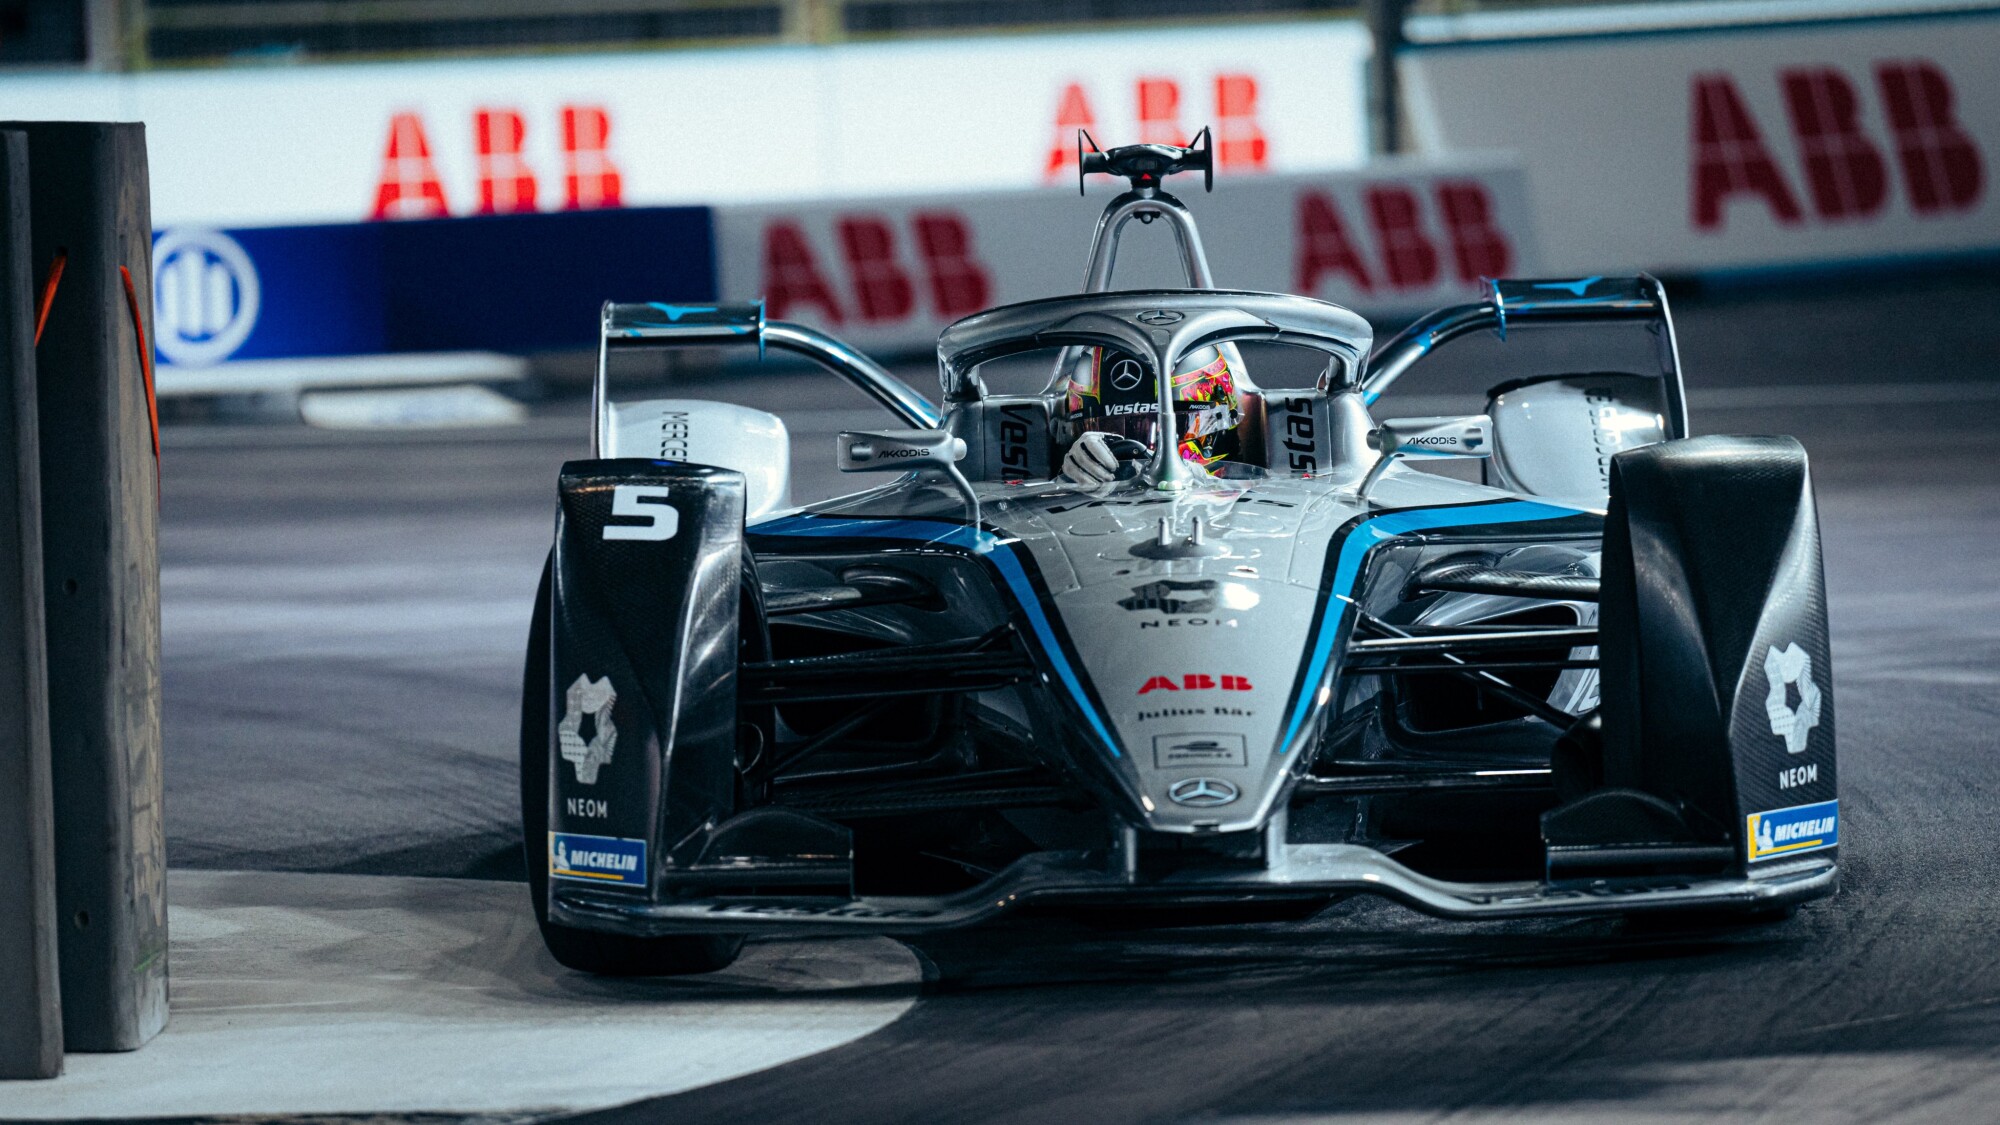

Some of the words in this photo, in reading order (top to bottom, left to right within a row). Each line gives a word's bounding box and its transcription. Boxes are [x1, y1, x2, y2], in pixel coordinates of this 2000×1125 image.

[1045, 74, 1268, 186] ABB
[1686, 58, 1984, 232] ABB
[366, 106, 622, 220] ABB
[1293, 178, 1514, 294] ABB
[763, 206, 993, 330] ABB
[1105, 402, 1160, 417] Vestas
[1282, 397, 1317, 475] stas
[660, 411, 689, 463] MERCE
[602, 485, 680, 541] 5
[1136, 673, 1254, 696] ABB
[1779, 763, 1818, 790] NEOM
[567, 798, 608, 819] NEOM
[1774, 816, 1836, 842] MICHELIN
[570, 850, 638, 872] MICHELIN
